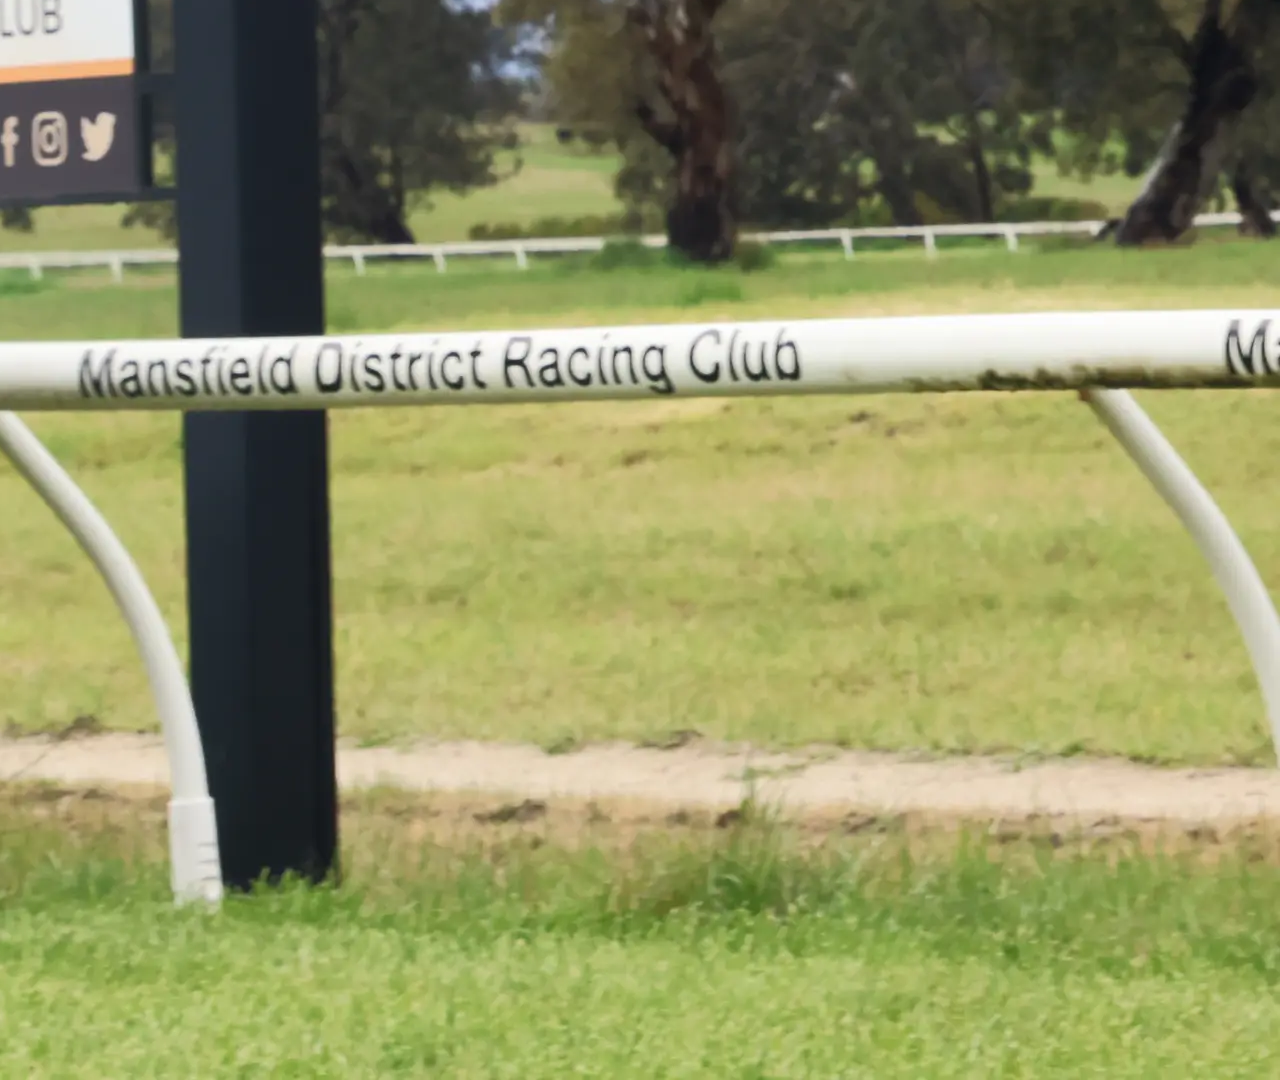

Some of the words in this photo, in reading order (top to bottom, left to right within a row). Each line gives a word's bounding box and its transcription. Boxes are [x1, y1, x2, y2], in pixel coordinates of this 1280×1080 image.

[77, 343, 297, 399] Mansfield
[314, 338, 488, 394] District
[503, 332, 676, 395] Racing
[689, 328, 802, 383] Club
